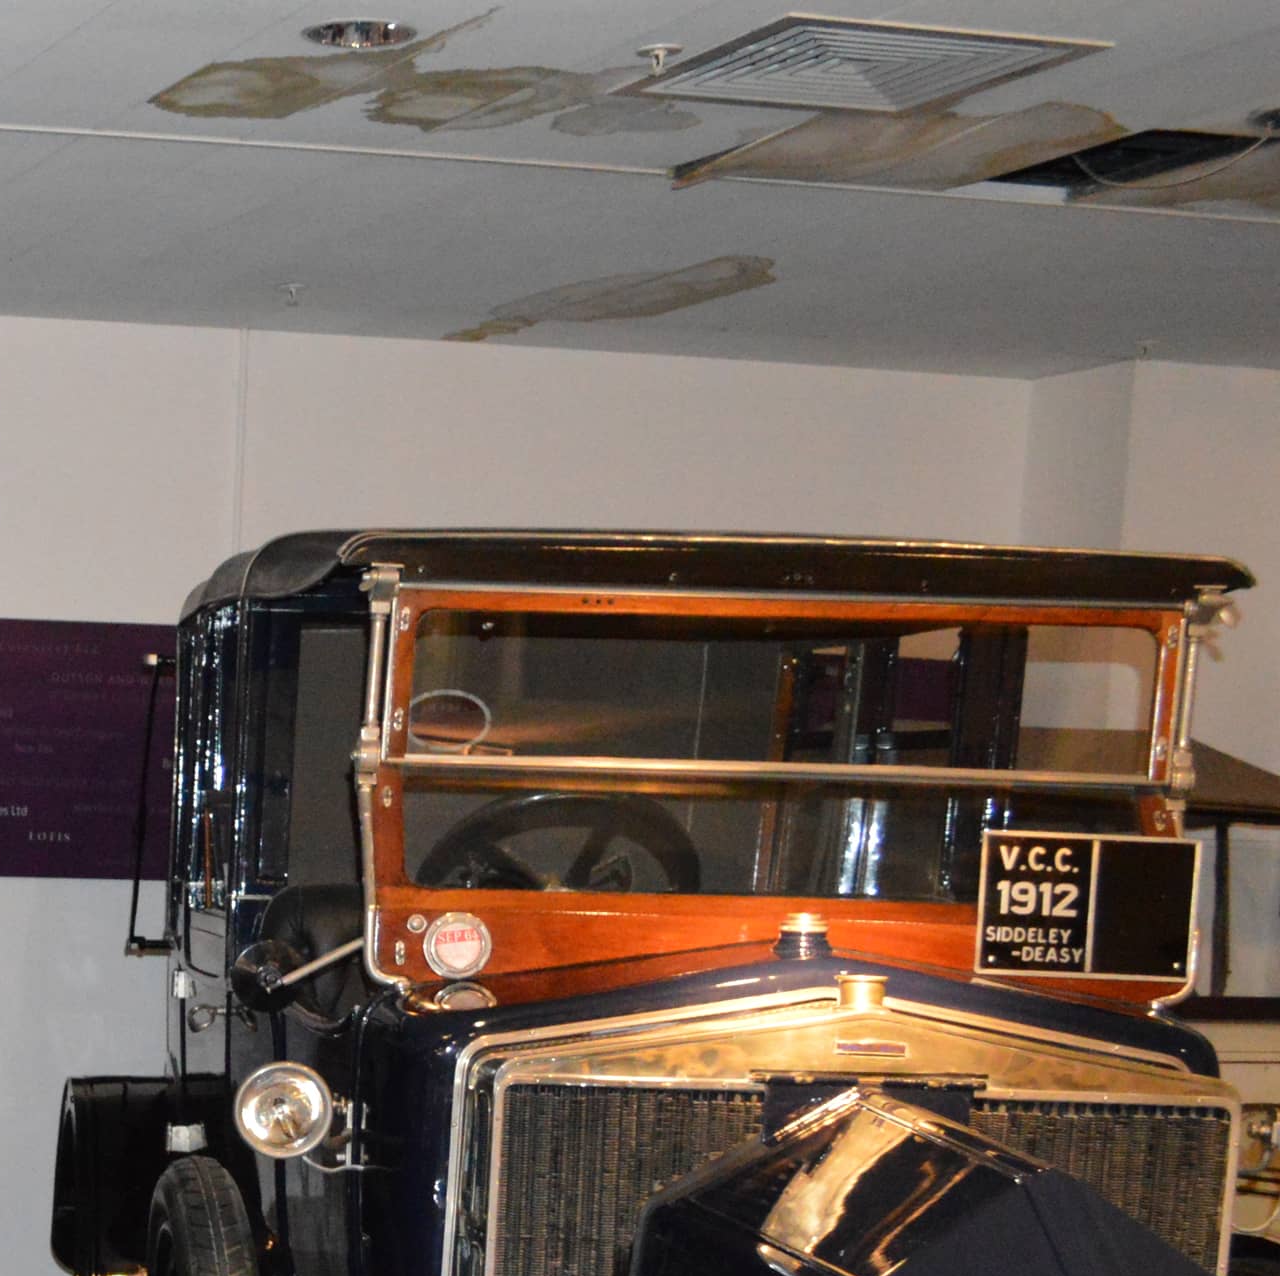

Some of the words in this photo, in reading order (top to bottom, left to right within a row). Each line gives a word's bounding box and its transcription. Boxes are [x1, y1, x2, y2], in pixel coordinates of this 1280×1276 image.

[10, 804, 29, 818] Ltd
[1000, 845, 1080, 875] V.C.C.
[996, 879, 1080, 918] 1912
[985, 924, 1073, 945] SIDDELEY
[1010, 944, 1085, 964] -DEASY
